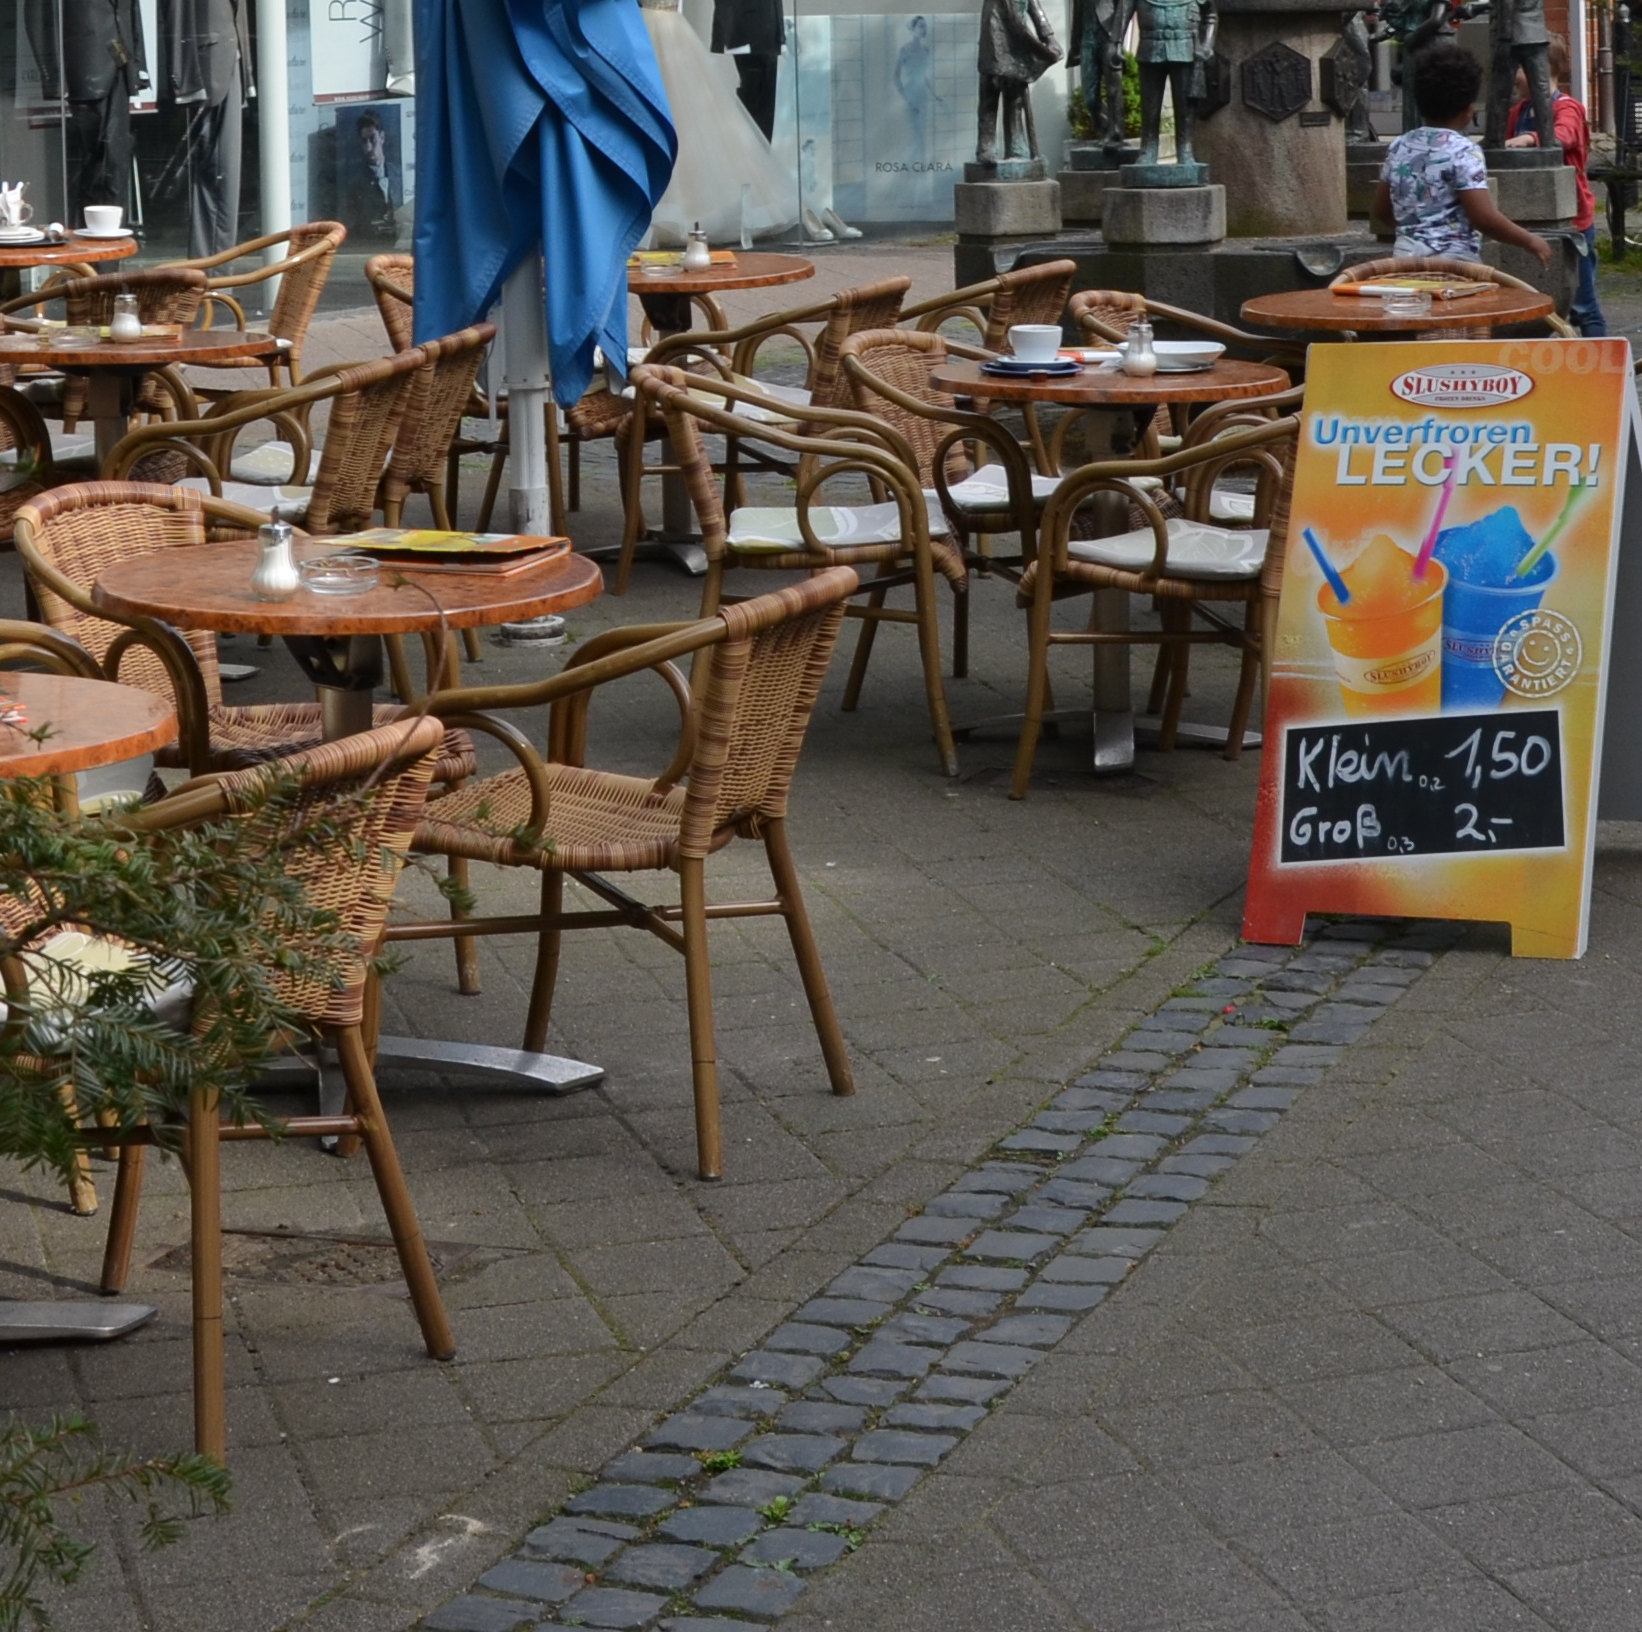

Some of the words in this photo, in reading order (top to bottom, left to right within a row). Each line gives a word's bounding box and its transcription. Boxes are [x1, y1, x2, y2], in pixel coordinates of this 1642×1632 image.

[875, 161, 910, 173] ROSA
[1499, 341, 1627, 375] COOL
[1401, 375, 1523, 397] SLUSHYBOY
[1314, 417, 1532, 445] Unverfroren
[1335, 442, 1602, 487] LECKER!
[1519, 616, 1571, 643] SPASS
[1500, 641, 1572, 691] GARANTIERT
[1297, 733, 1413, 793] Klein
[1443, 727, 1552, 790] 1,50
[1289, 803, 1382, 850] Groß
